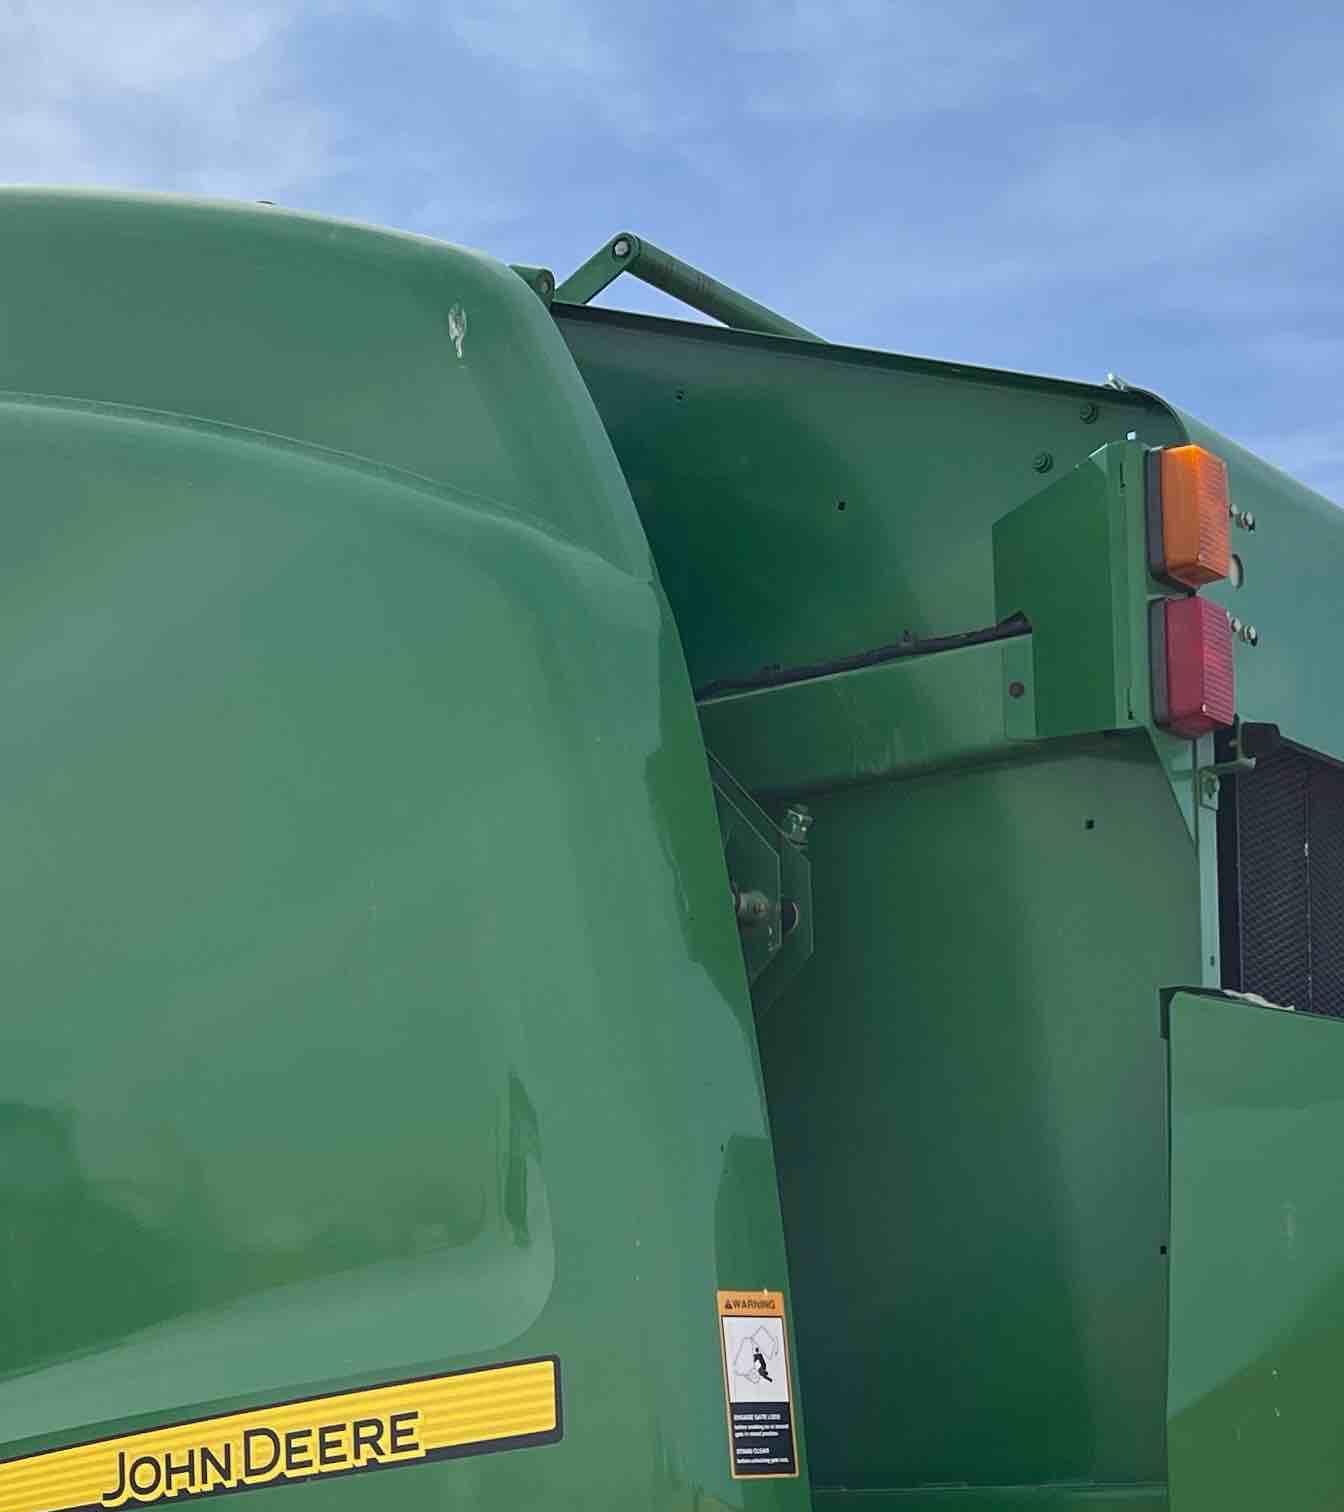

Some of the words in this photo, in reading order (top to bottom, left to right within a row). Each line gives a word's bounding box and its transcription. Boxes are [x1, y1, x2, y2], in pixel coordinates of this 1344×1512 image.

[735, 1298, 776, 1310] WARNING
[101, 1443, 233, 1502] JOHN
[243, 1410, 421, 1477] DEERE
